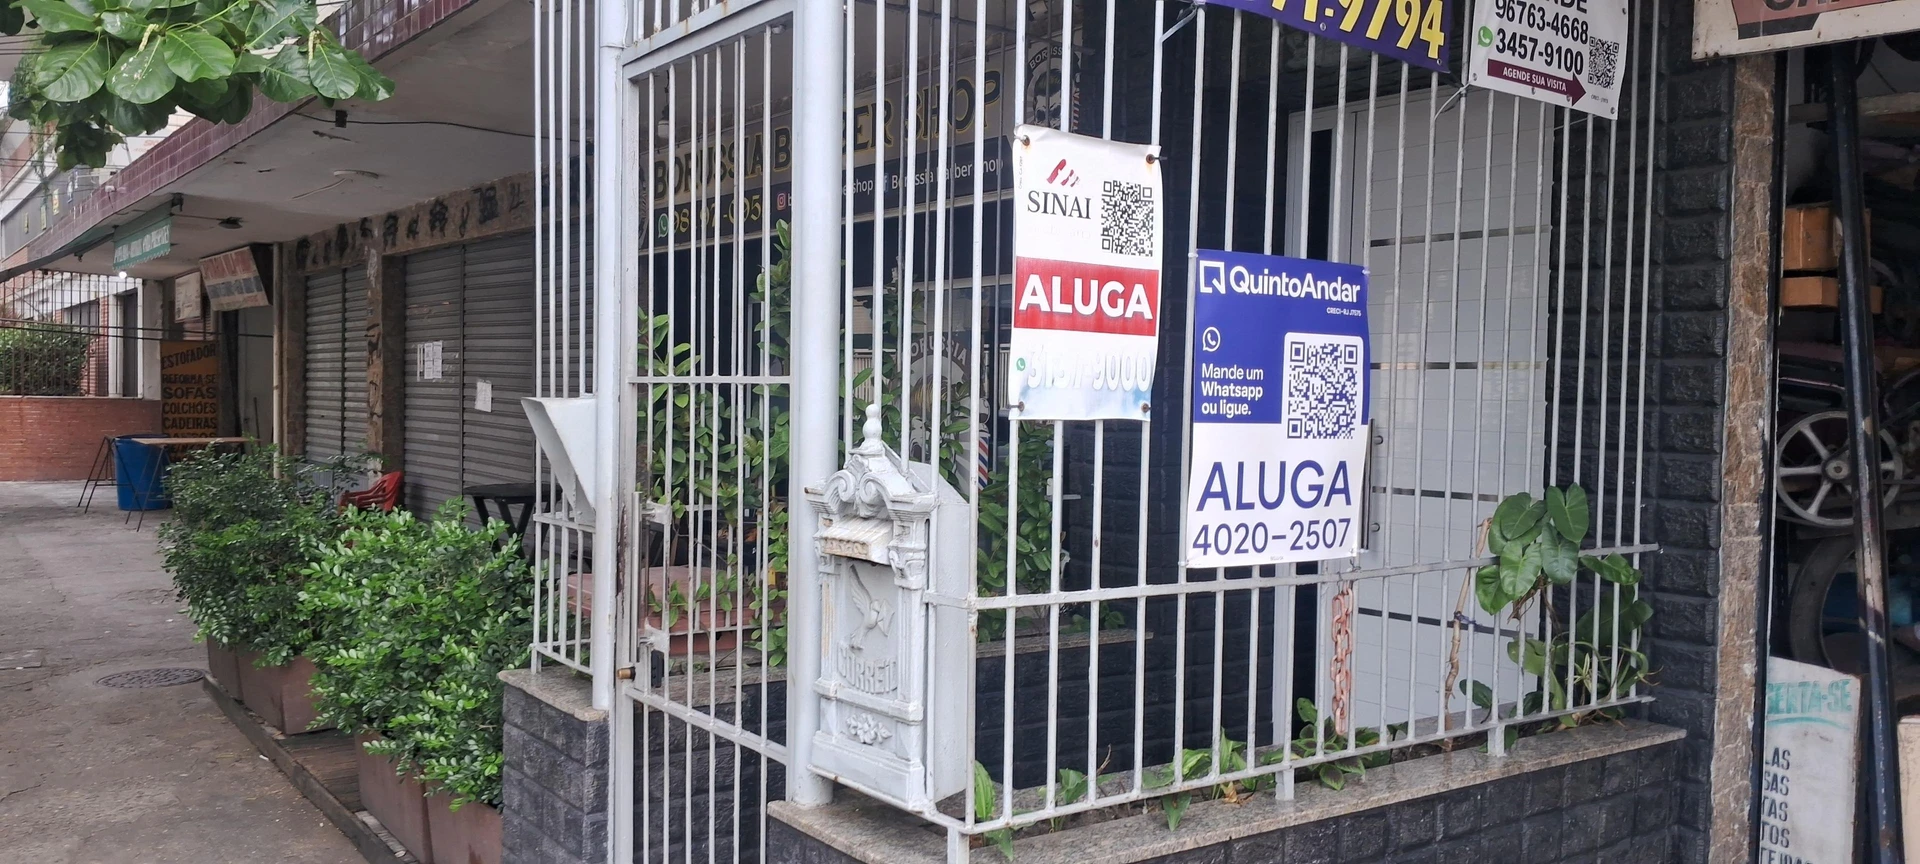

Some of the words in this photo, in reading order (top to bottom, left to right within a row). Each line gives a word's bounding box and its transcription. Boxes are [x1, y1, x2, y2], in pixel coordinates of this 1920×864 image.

[1495, 0, 1589, 45] 96763-4668
[1496, 28, 1584, 75] 3457-9100
[1502, 66, 1531, 83] AGENDE
[1531, 74, 1546, 86] SUA
[1545, 78, 1567, 92] VISITA
[1027, 190, 1092, 220] SINAI
[1018, 273, 1153, 320] ALUGA
[1229, 265, 1361, 303] QuintoAndar
[161, 343, 216, 371] ESTOFADOR
[1201, 363, 1244, 380] Mande
[1246, 368, 1264, 381] um
[1201, 380, 1264, 401] Whatsapp
[163, 417, 217, 430] CADEIRAS
[1201, 403, 1218, 414] ou
[1219, 400, 1251, 419] ligue.
[1196, 460, 1352, 511] ALUGA
[1192, 518, 1351, 556] 4020-2507
